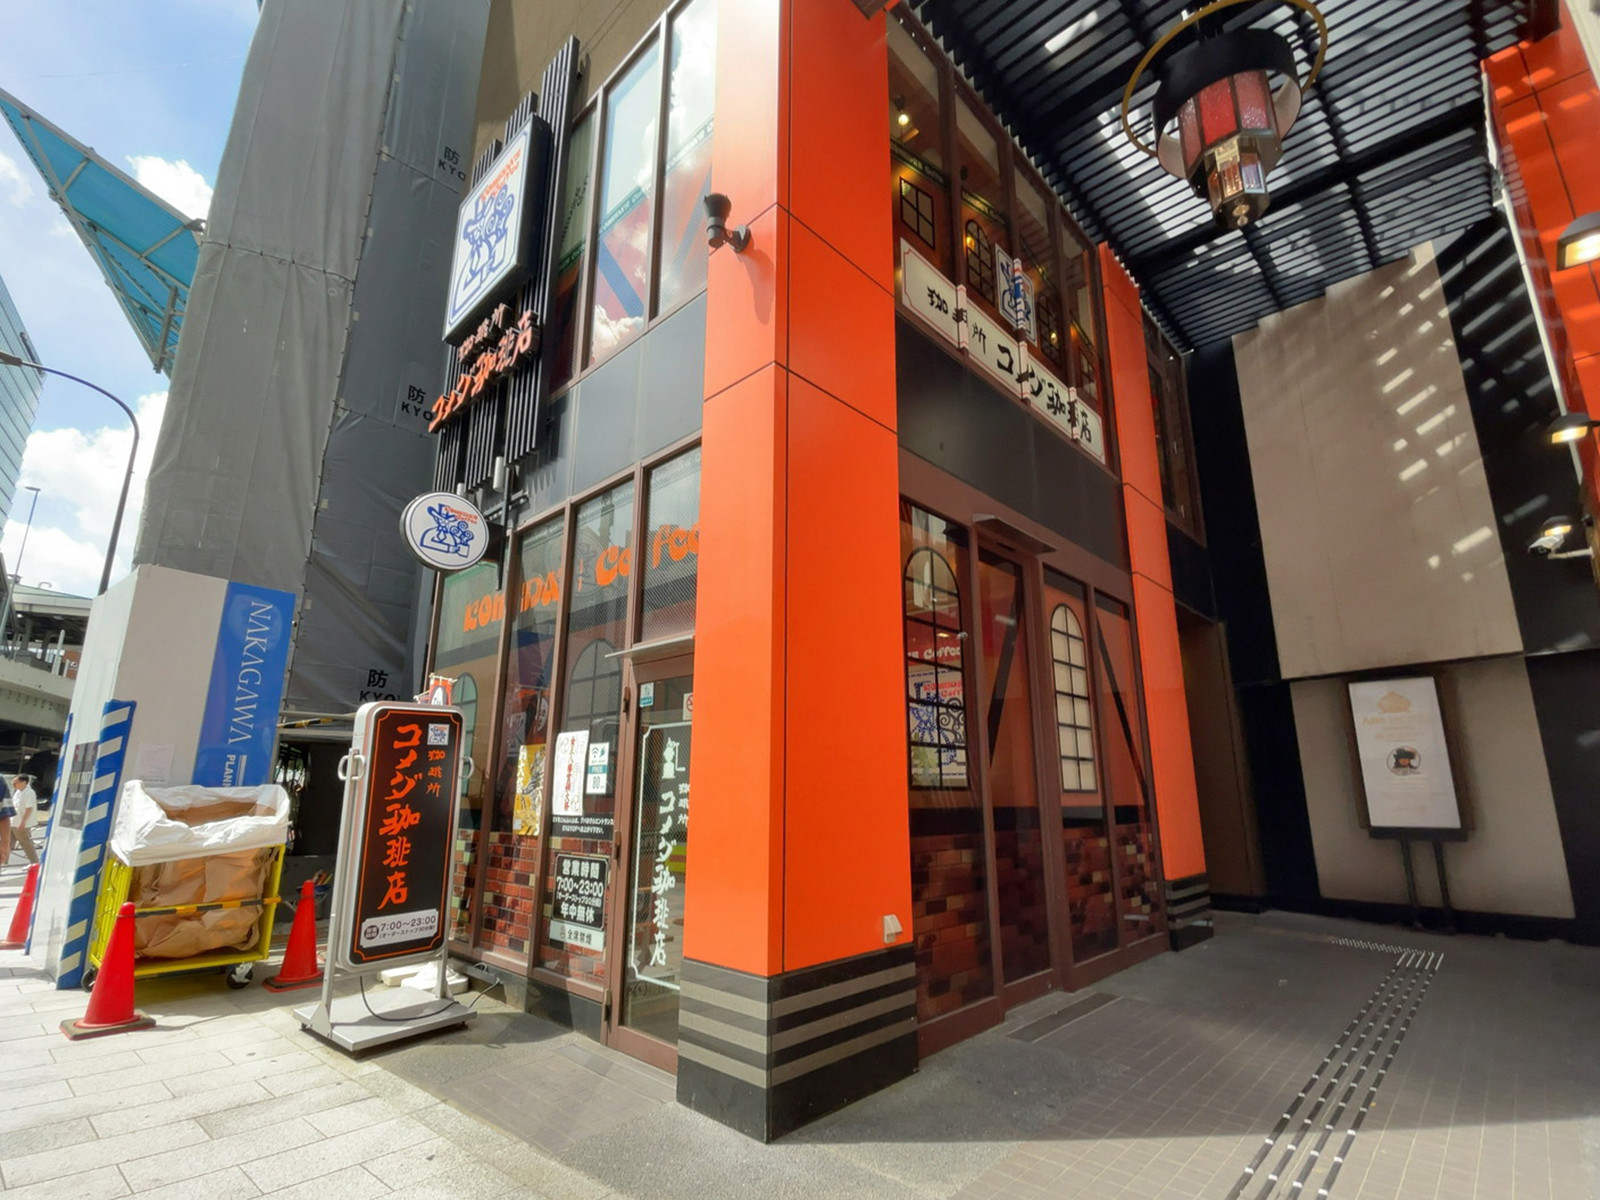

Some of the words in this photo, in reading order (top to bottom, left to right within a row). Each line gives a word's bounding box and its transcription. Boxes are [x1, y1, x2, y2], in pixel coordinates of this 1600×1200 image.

[444, 145, 460, 165] 防
[408, 384, 426, 404] 防
[227, 600, 274, 745] NAKAGAWA
[367, 668, 389, 688] 防
[426, 750, 446, 798] 珈琲所
[377, 723, 423, 910] コメダ珈琲店
[562, 858, 600, 880] 営業時間
[650, 790, 677, 966] コメダ珈琲店
[560, 901, 595, 924] 年中無休
